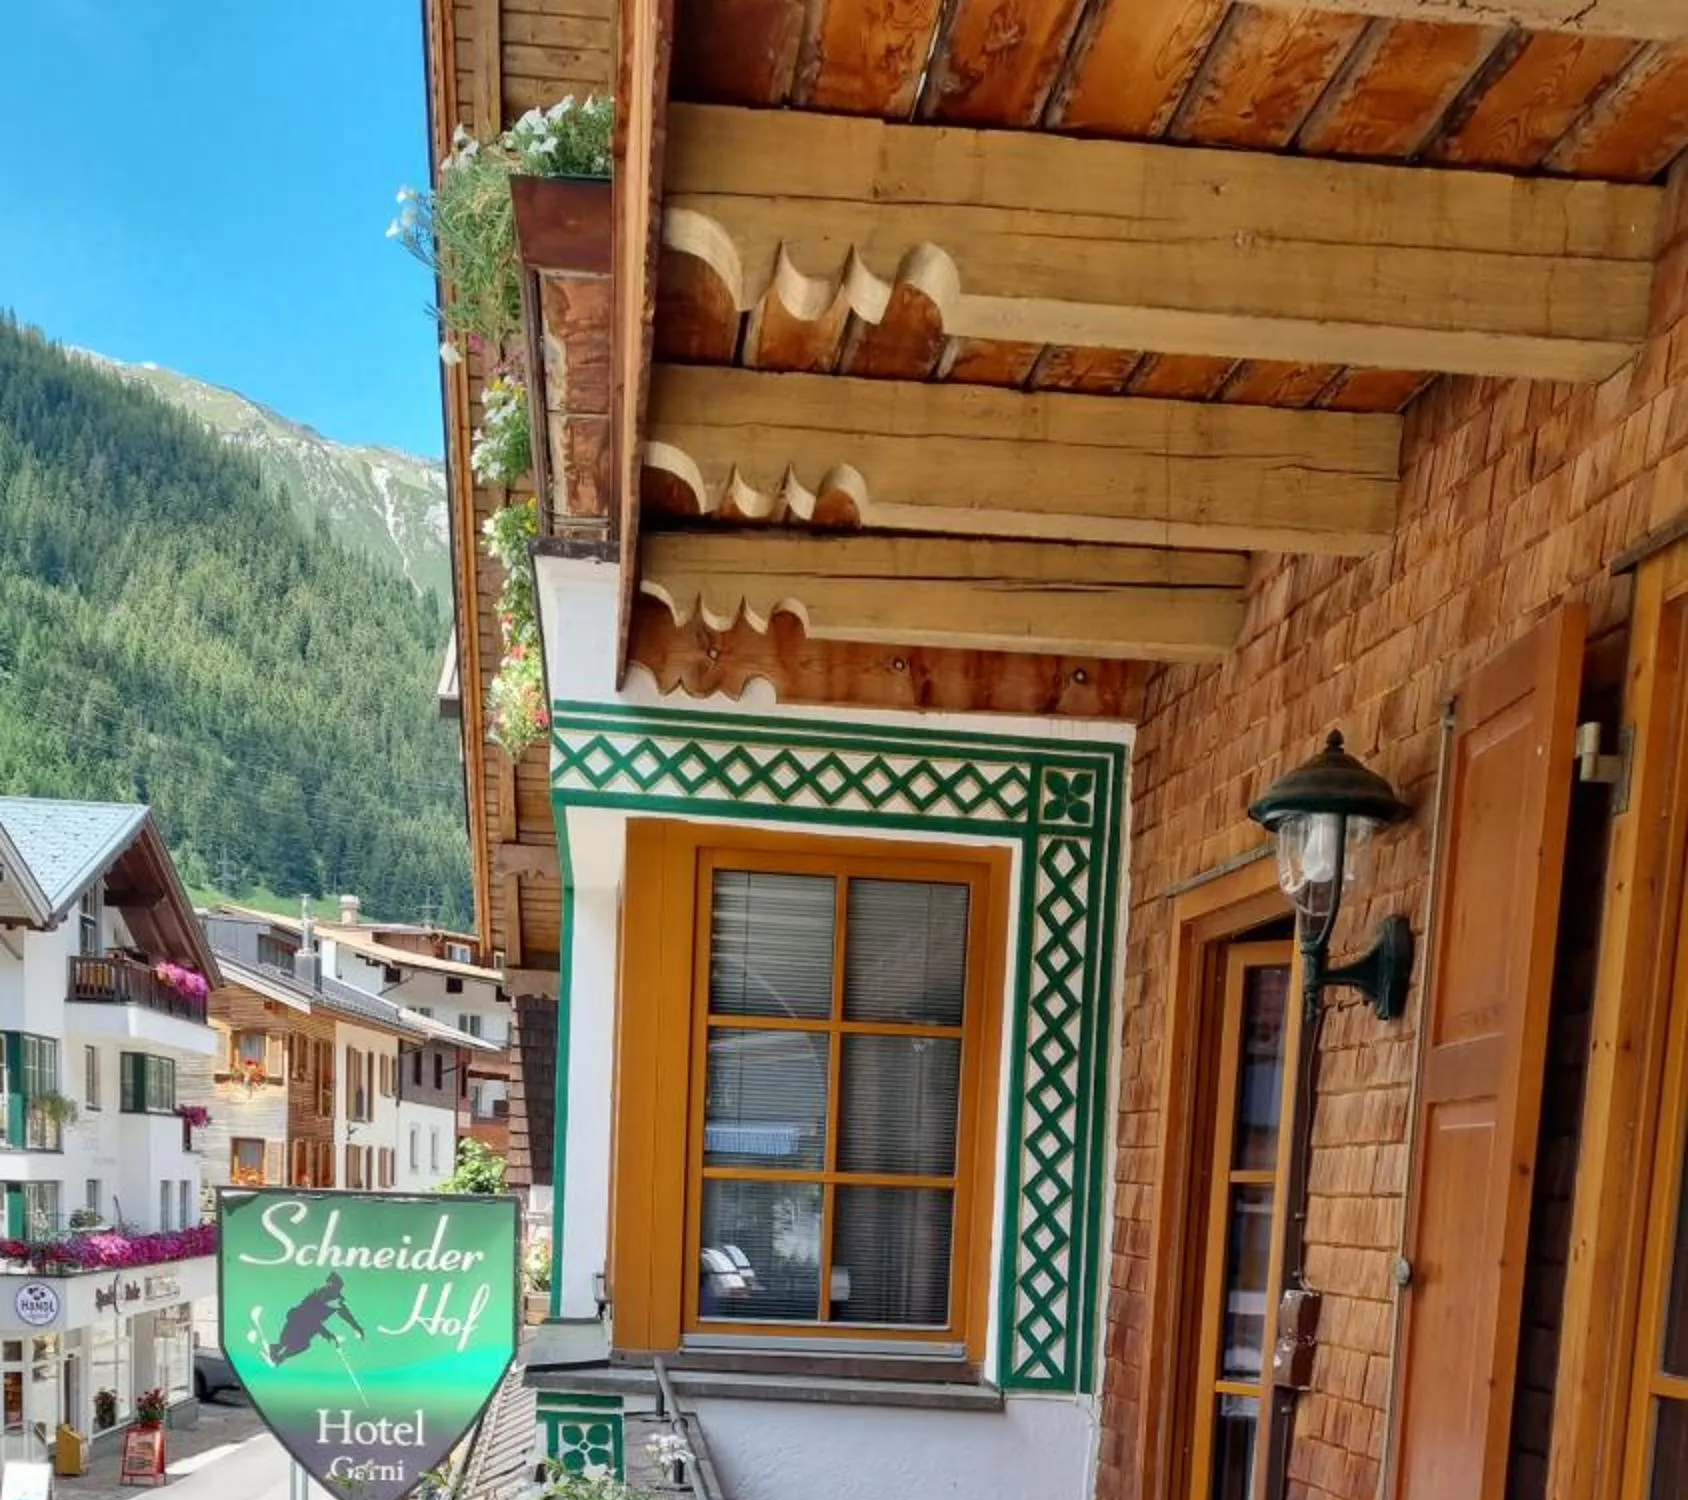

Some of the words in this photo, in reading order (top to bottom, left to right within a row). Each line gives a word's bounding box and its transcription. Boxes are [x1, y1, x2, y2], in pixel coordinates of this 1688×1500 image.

[239, 1201, 483, 1272] Schneider
[377, 1283, 490, 1352] Hof
[316, 1408, 425, 1446] Hotel
[329, 1455, 404, 1481] Garni
